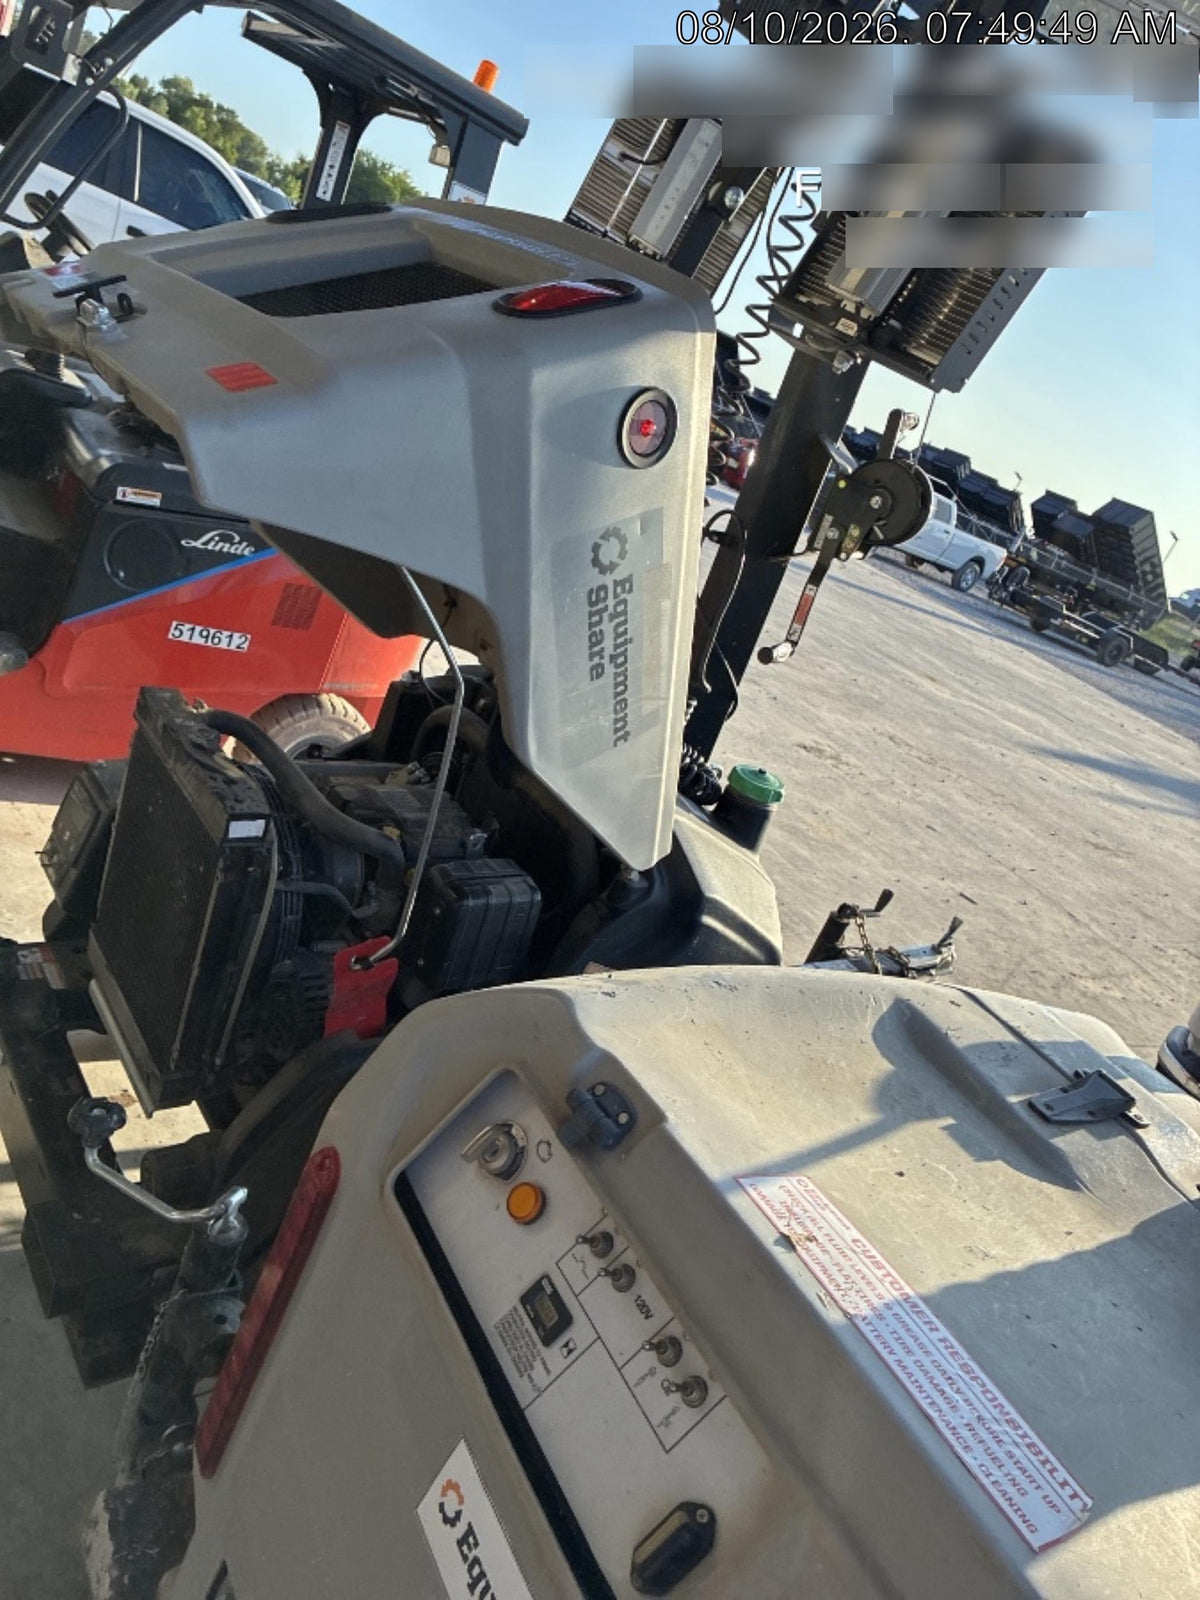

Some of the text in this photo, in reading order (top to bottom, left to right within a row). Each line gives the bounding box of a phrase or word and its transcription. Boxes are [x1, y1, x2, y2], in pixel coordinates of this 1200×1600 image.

[181, 529, 255, 556] Linde
[170, 622, 249, 650] 519612
[587, 583, 608, 681] Share
[609, 574, 633, 747] Equipment
[791, 1235, 849, 1298] QUIPMENT
[891, 1358, 976, 1454] MAINTENANCE
[976, 1461, 1039, 1535] CLEANING
[850, 1237, 1091, 1513] CUSTOMER RESPONSIBILITY
[961, 1421, 1030, 1499] REFUELING
[1003, 1447, 1042, 1491] START
[1040, 1492, 1062, 1516] UP
